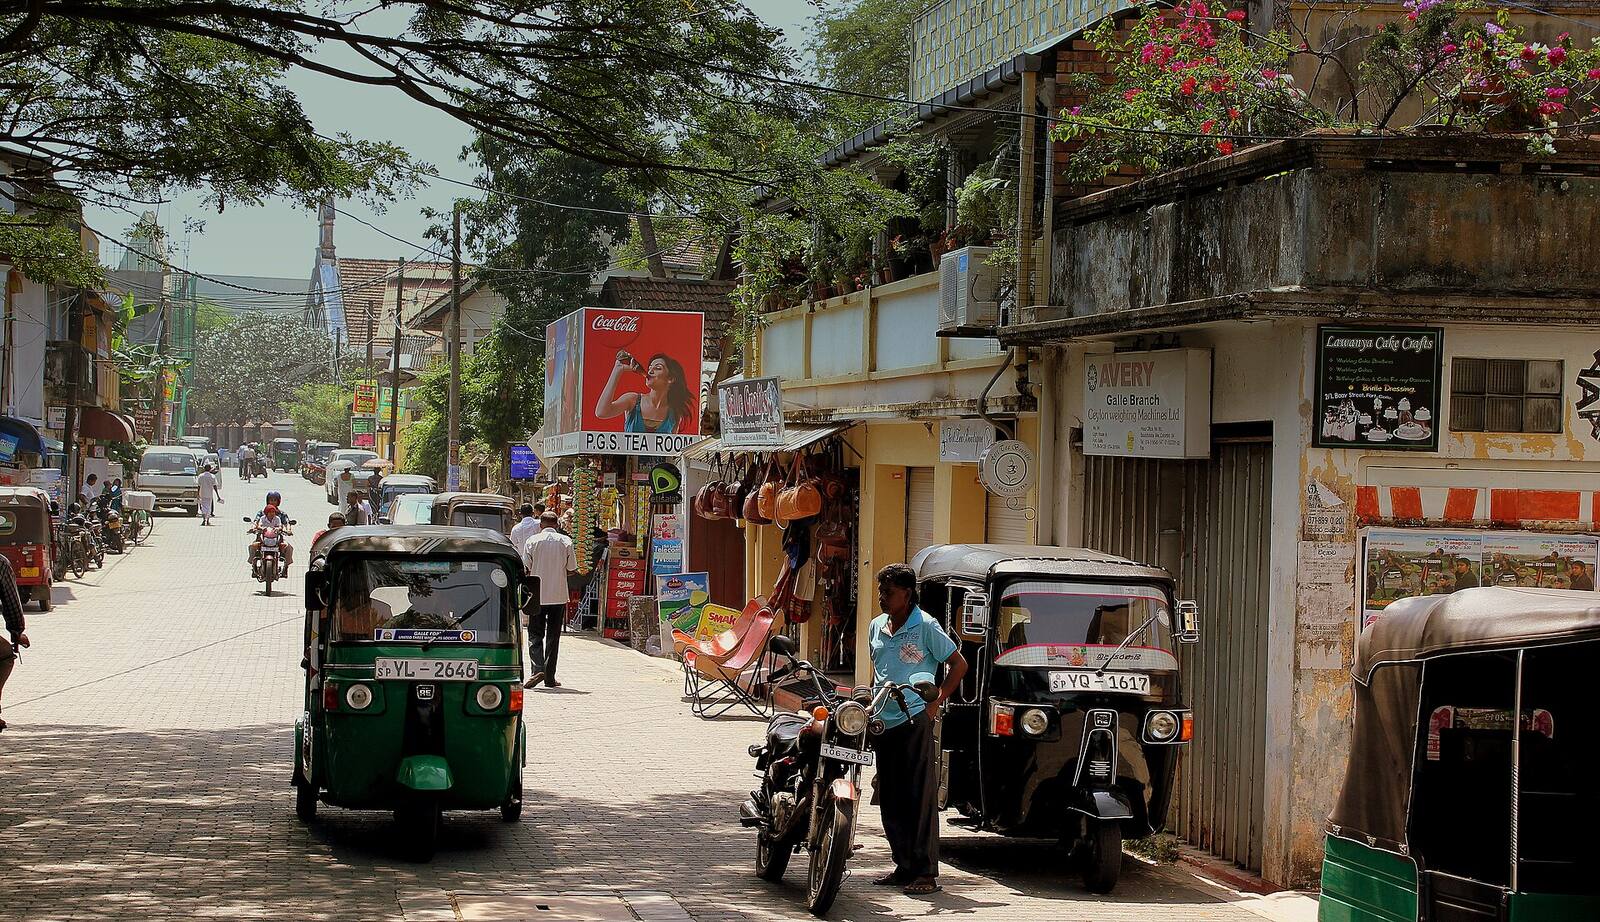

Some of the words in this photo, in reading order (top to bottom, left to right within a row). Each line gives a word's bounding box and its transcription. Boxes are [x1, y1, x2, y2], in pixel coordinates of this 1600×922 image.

[592, 314, 640, 332] Coca-Cola
[1325, 335, 1373, 352] Lawanya
[1375, 335, 1400, 352] Cake
[1402, 335, 1433, 353] Crafts
[1100, 361, 1154, 388] AVERY
[1106, 394, 1127, 406] Galle
[1130, 394, 1160, 406] Branch
[1088, 408, 1108, 422] Ceylon
[1109, 409, 1137, 423] weighing
[1137, 409, 1167, 421] Machines
[1168, 408, 1180, 421] Ltd
[586, 434, 620, 450] P.G.S.
[625, 435, 649, 452] TEA
[655, 435, 693, 452] ROOM
[378, 667, 391, 677] SP
[393, 661, 415, 677] YL
[435, 662, 476, 678] 2646
[1053, 679, 1066, 688] SP
[1068, 674, 1089, 688] YQ
[1109, 676, 1148, 691] 1617
[824, 748, 869, 761] 106-7805
